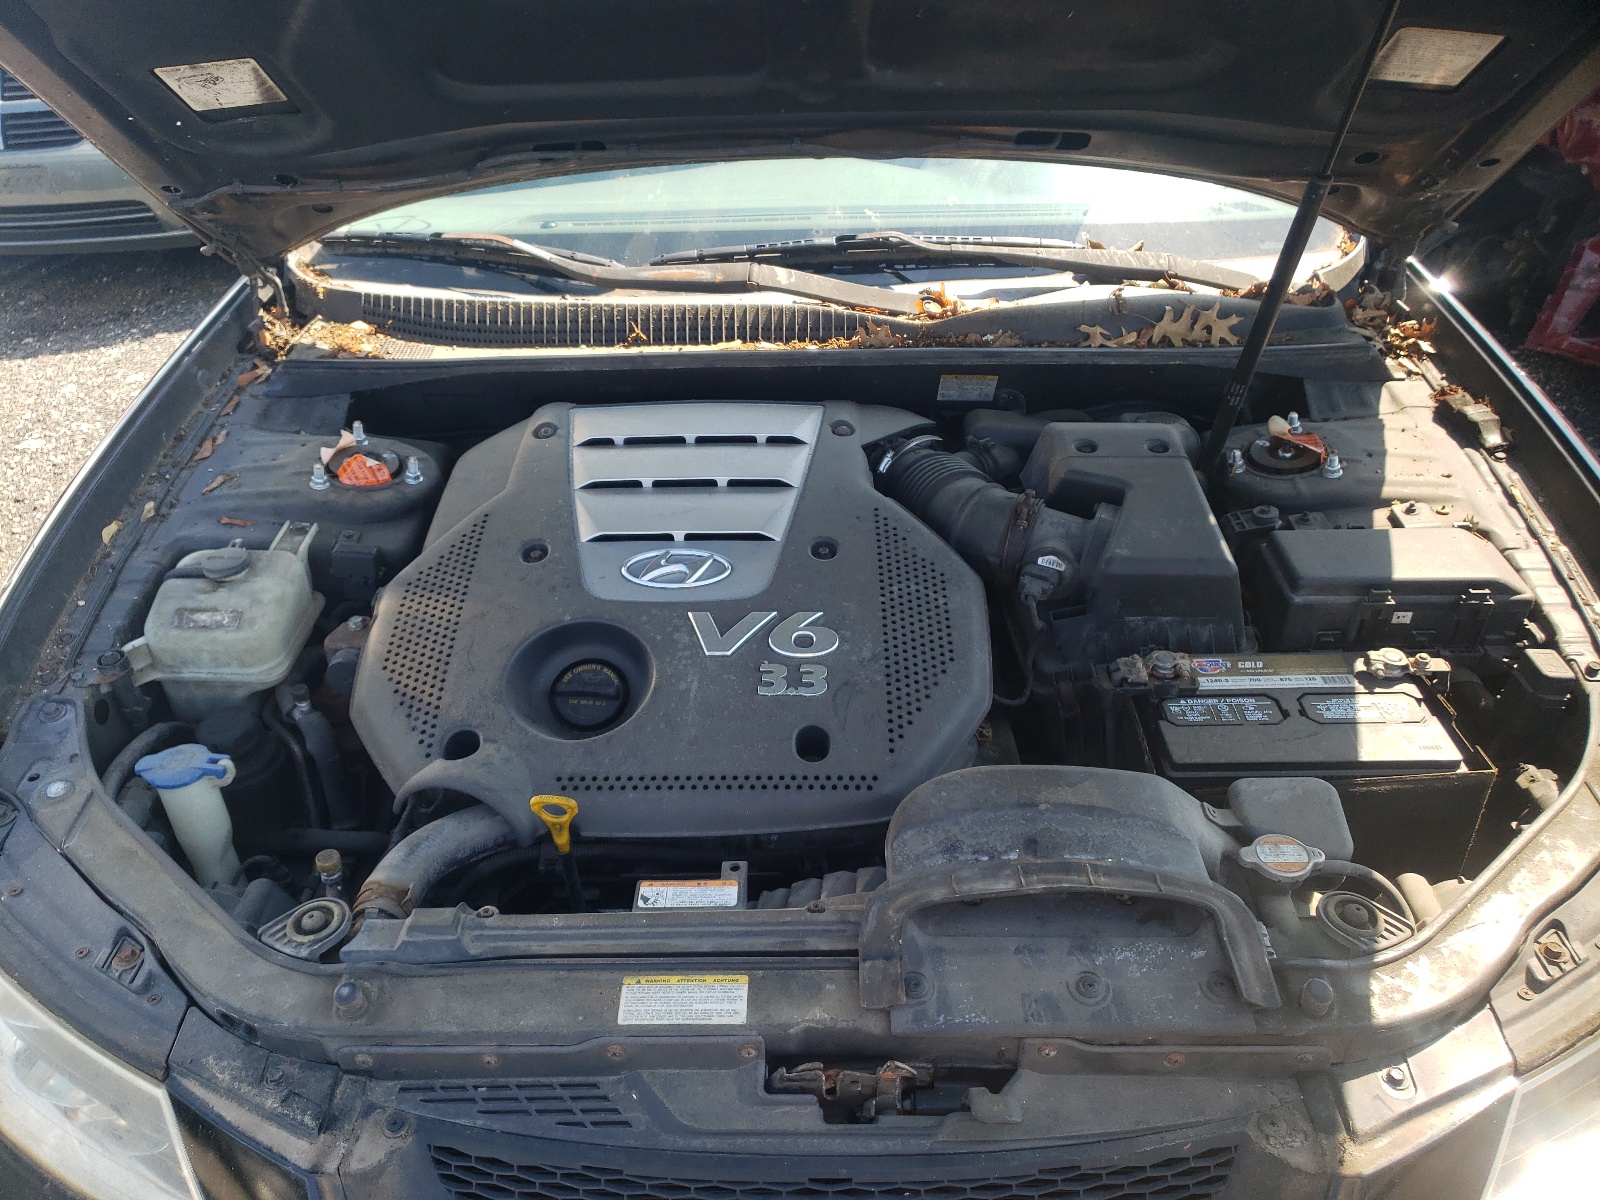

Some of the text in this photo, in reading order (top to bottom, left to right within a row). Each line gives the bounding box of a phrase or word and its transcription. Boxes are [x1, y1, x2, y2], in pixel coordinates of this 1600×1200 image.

[687, 611, 839, 658] V6
[562, 664, 619, 686] SEE OWNER'S MANUAL
[1238, 661, 1264, 669] GOLD
[757, 663, 828, 696] 3.3
